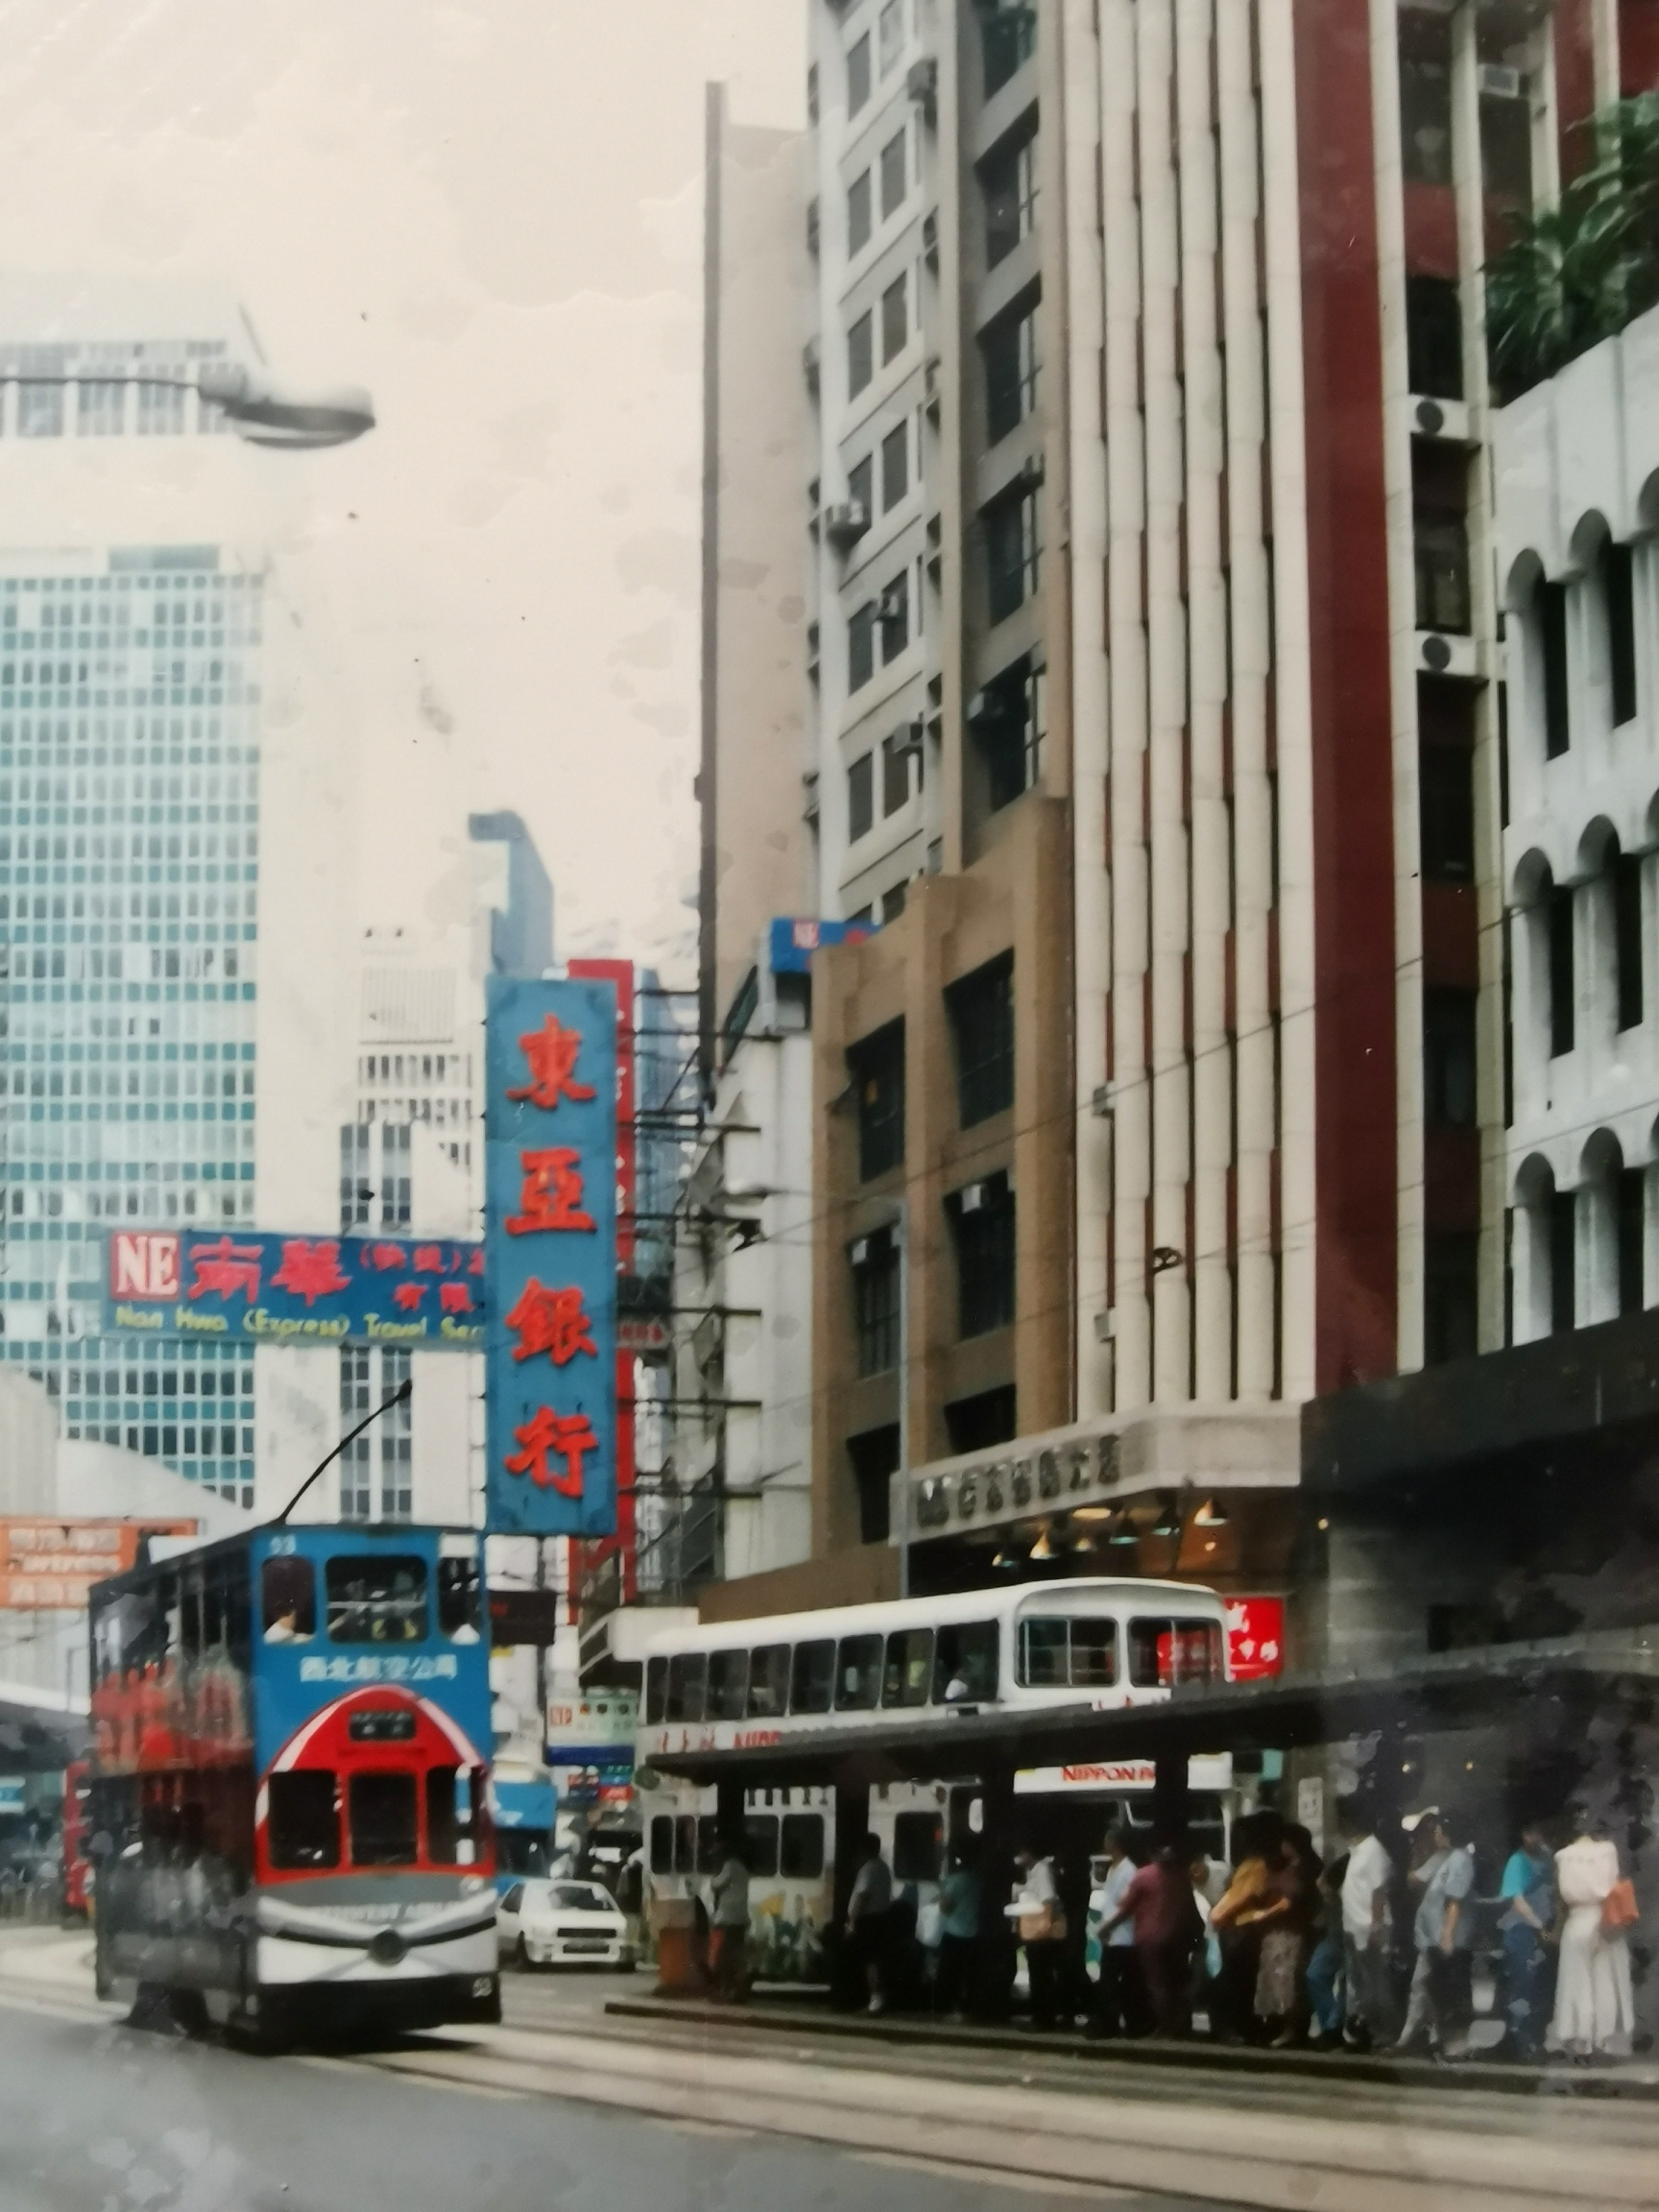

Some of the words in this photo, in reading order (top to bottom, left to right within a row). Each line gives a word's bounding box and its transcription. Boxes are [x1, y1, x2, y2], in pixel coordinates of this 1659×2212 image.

[116, 1235, 179, 1296] NE
[187, 1236, 352, 1308] 南華
[504, 1012, 599, 1500] 東亞銀行
[362, 1311, 427, 1339] Travel
[1062, 1765, 1136, 1782] NIPPON
